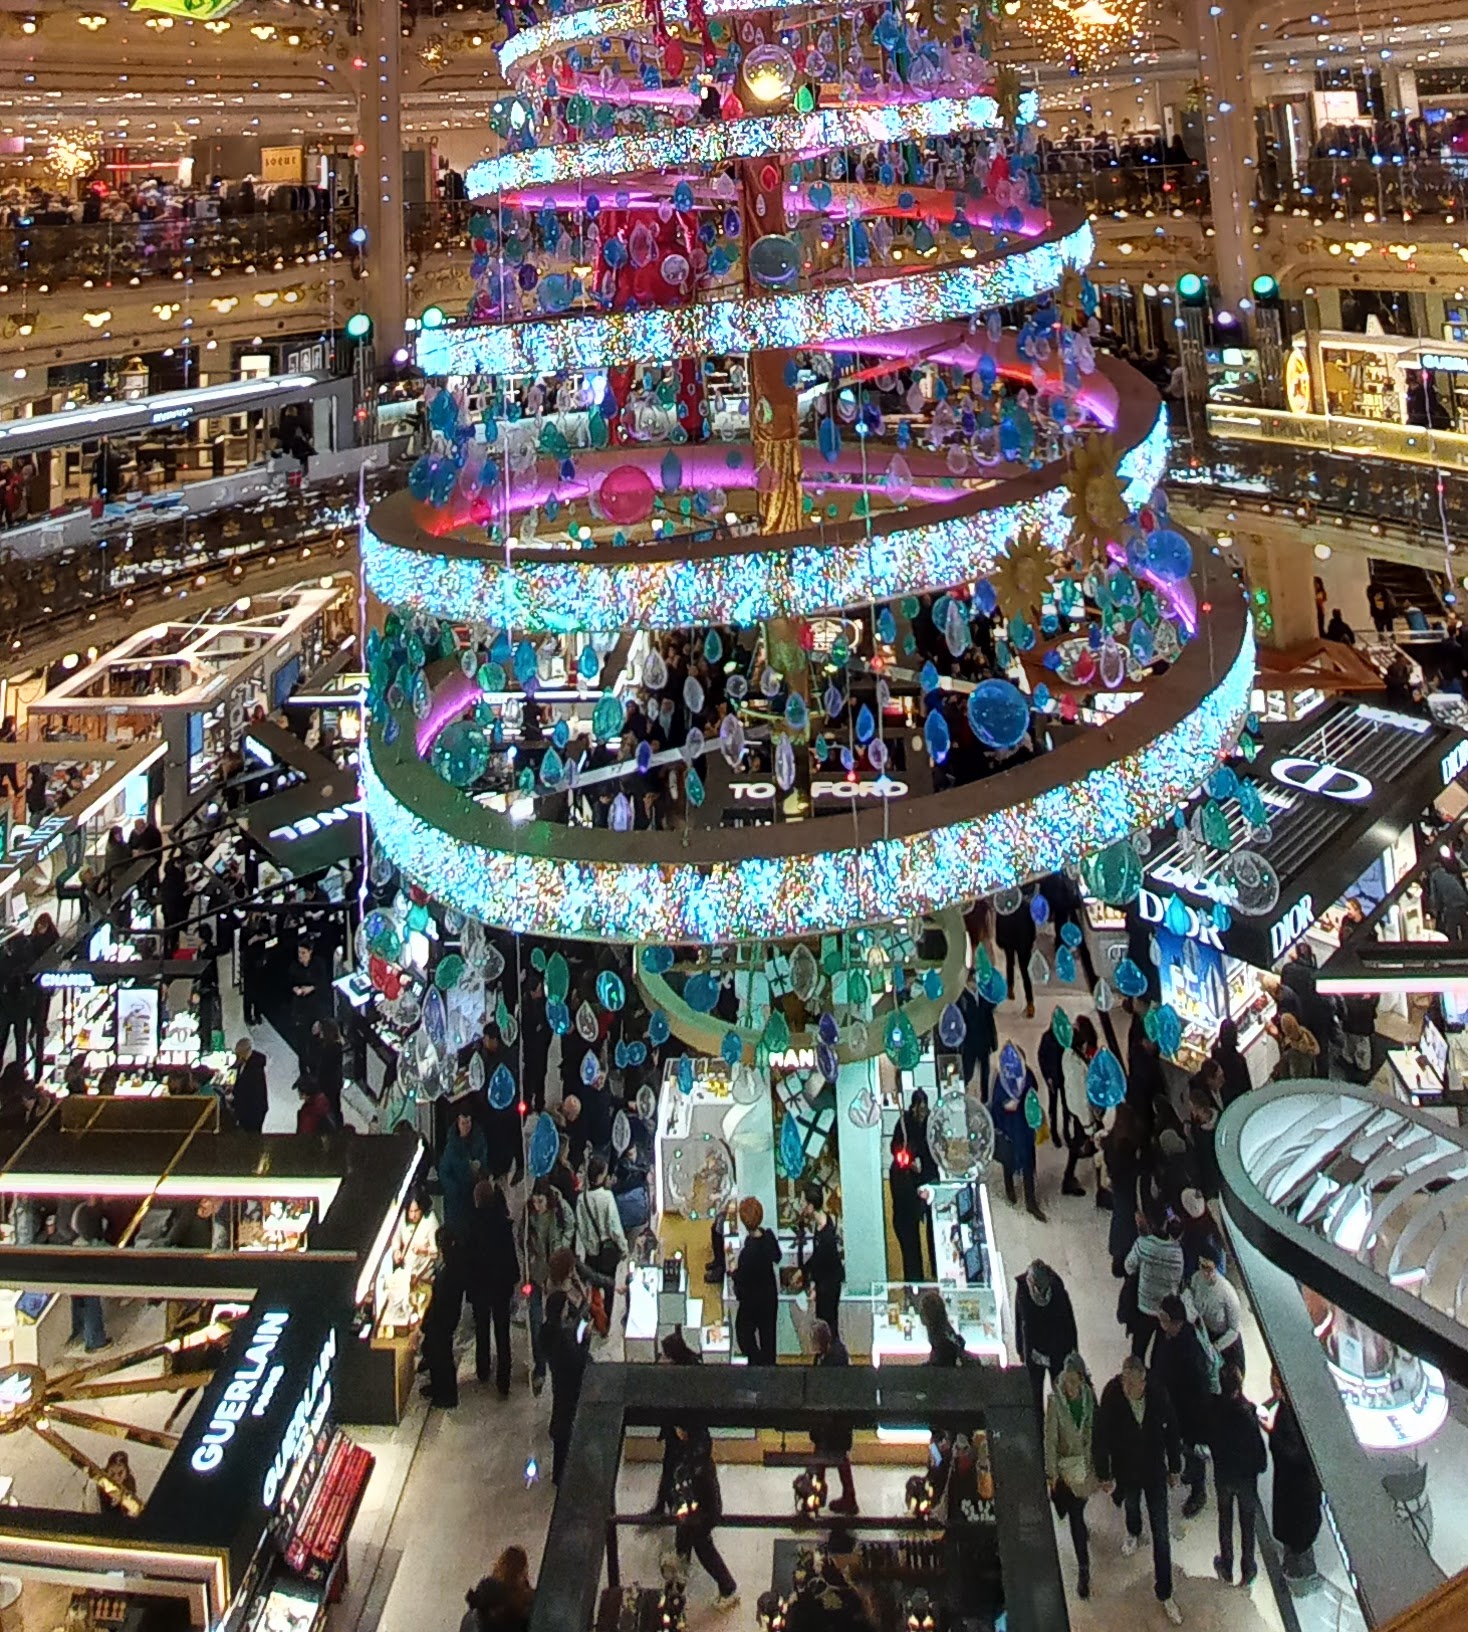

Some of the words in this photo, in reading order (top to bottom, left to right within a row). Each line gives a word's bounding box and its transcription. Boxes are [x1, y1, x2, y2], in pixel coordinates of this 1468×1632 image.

[810, 781, 909, 798] FORD
[1270, 894, 1315, 959] DIOR
[40, 973, 96, 987] CHANEL
[191, 1312, 289, 1471] GUERLAIN
